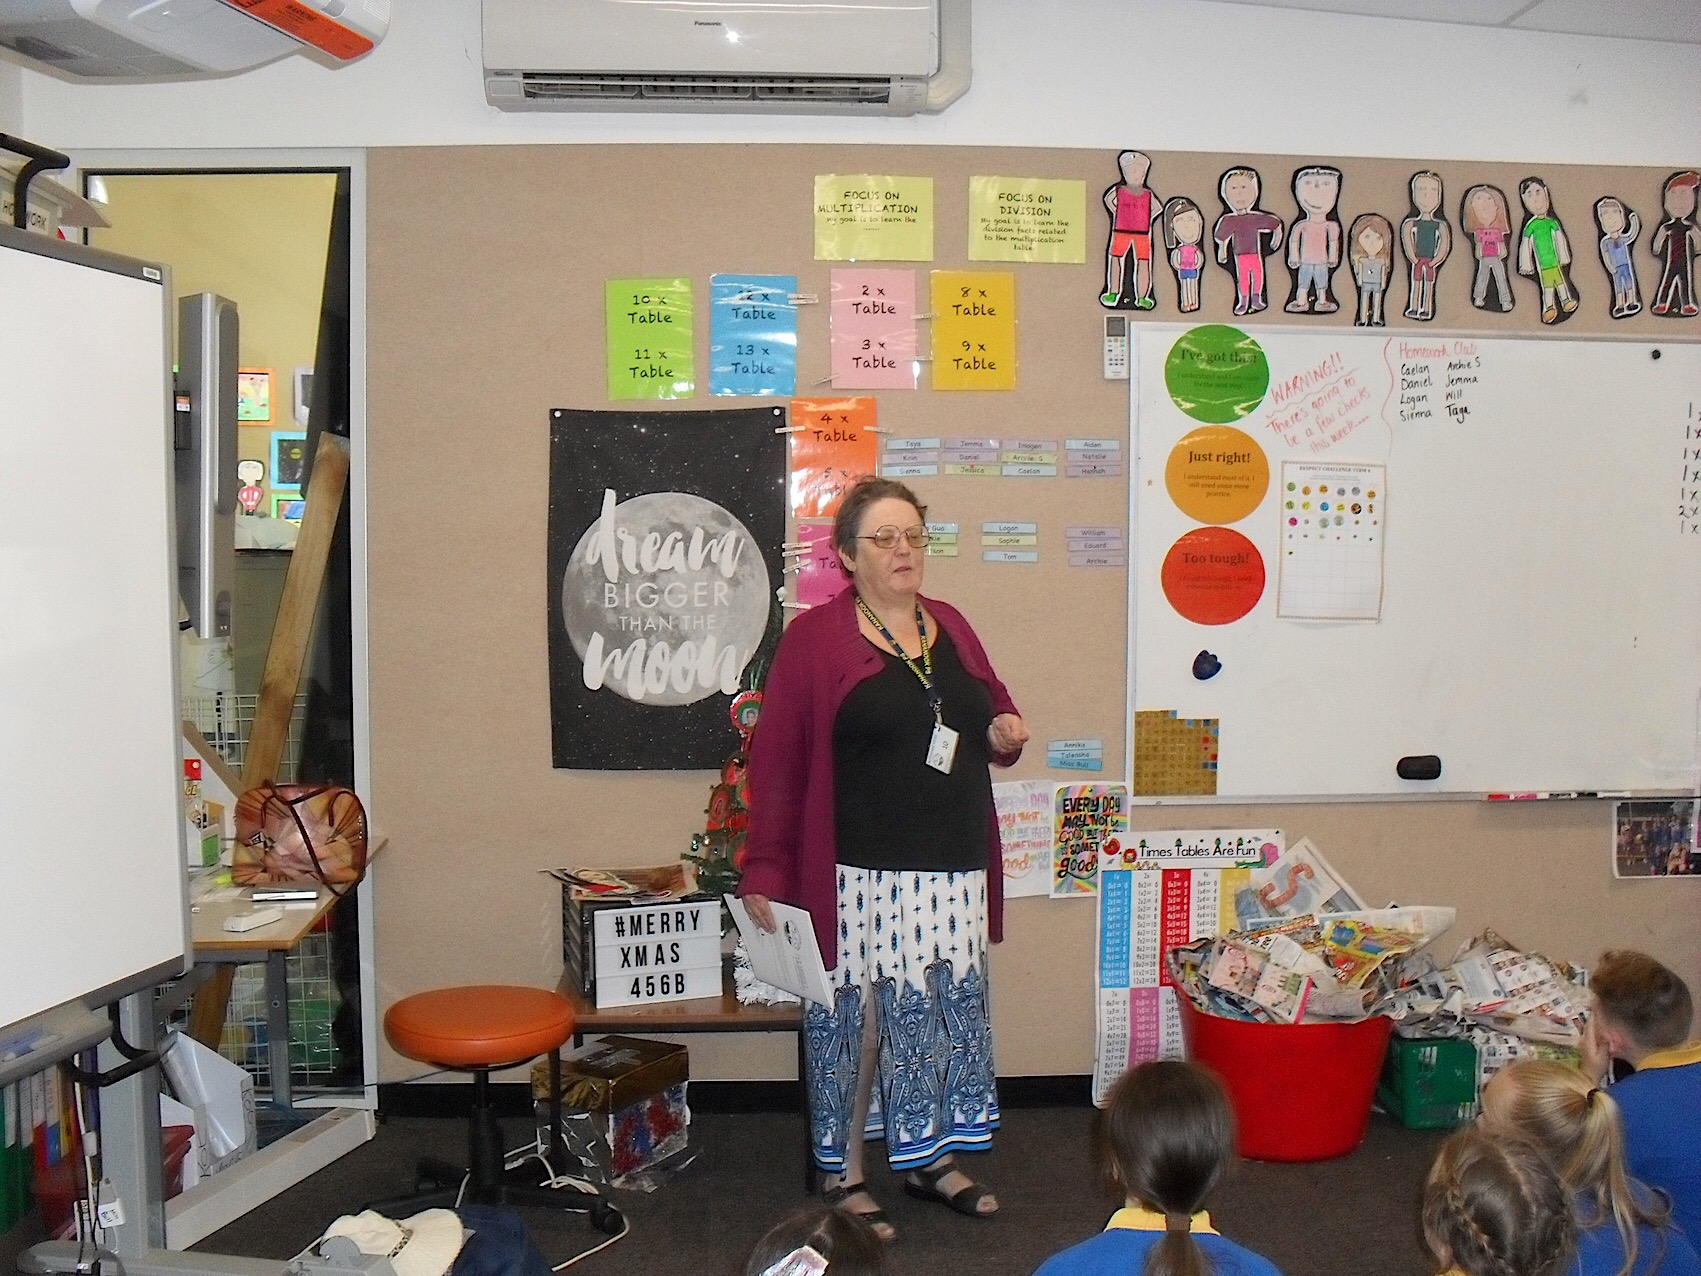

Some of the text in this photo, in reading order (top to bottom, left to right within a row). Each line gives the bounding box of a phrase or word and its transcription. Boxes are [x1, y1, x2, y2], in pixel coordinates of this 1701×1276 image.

[844, 191, 900, 200] FOCUS ON
[998, 193, 1053, 204] FOCUS ON
[818, 203, 918, 213] MULTIPLICATION
[1000, 206, 1051, 216] DIVISION
[840, 216, 856, 225] goal
[993, 218, 1010, 226] goal
[983, 224, 1013, 233] division
[1010, 236, 1064, 245] multiplication
[762, 292, 770, 301] x
[862, 285, 885, 296] 2 x
[960, 286, 987, 298] 8 x
[633, 295, 667, 305] 10 x
[732, 306, 776, 320] Table
[852, 303, 897, 315] Table
[952, 304, 996, 316] Table
[628, 310, 673, 324] Table
[736, 344, 770, 356] 13 x
[862, 339, 886, 350] 3 x
[961, 340, 986, 352] 9 x
[635, 349, 667, 359] 11 x
[1182, 349, 1202, 360] I've
[1206, 352, 1226, 364] got
[1399, 343, 1448, 359] Homework
[731, 361, 776, 375] Table
[852, 357, 897, 369] Table
[953, 358, 997, 370] Table
[1447, 356, 1481, 371] Archie S
[629, 364, 674, 379] Table
[1400, 363, 1430, 376] Caelan
[1401, 375, 1433, 391] Daniel
[1445, 374, 1479, 388] Jemma
[1446, 389, 1462, 401] Will
[1400, 393, 1428, 410] Logan
[820, 414, 849, 424] 4 x
[1399, 410, 1433, 422] Sienna
[813, 430, 857, 442] Table
[1305, 428, 1313, 437] a
[1189, 451, 1250, 465] Just right!
[1678, 505, 1690, 519] 2
[586, 488, 745, 583] dream
[998, 537, 1020, 545] Sophie
[1183, 553, 1249, 566] Too tough!
[604, 581, 730, 608] BIGGER
[619, 614, 717, 631] THAN THE
[583, 631, 748, 700] moon
[1063, 797, 1099, 813] EVERY
[1139, 845, 1256, 857] Times Tables Are Fun
[1058, 855, 1098, 878] good
[615, 909, 700, 938] #MERRY
[621, 942, 680, 968] XMAS
[630, 973, 685, 998] 456B
